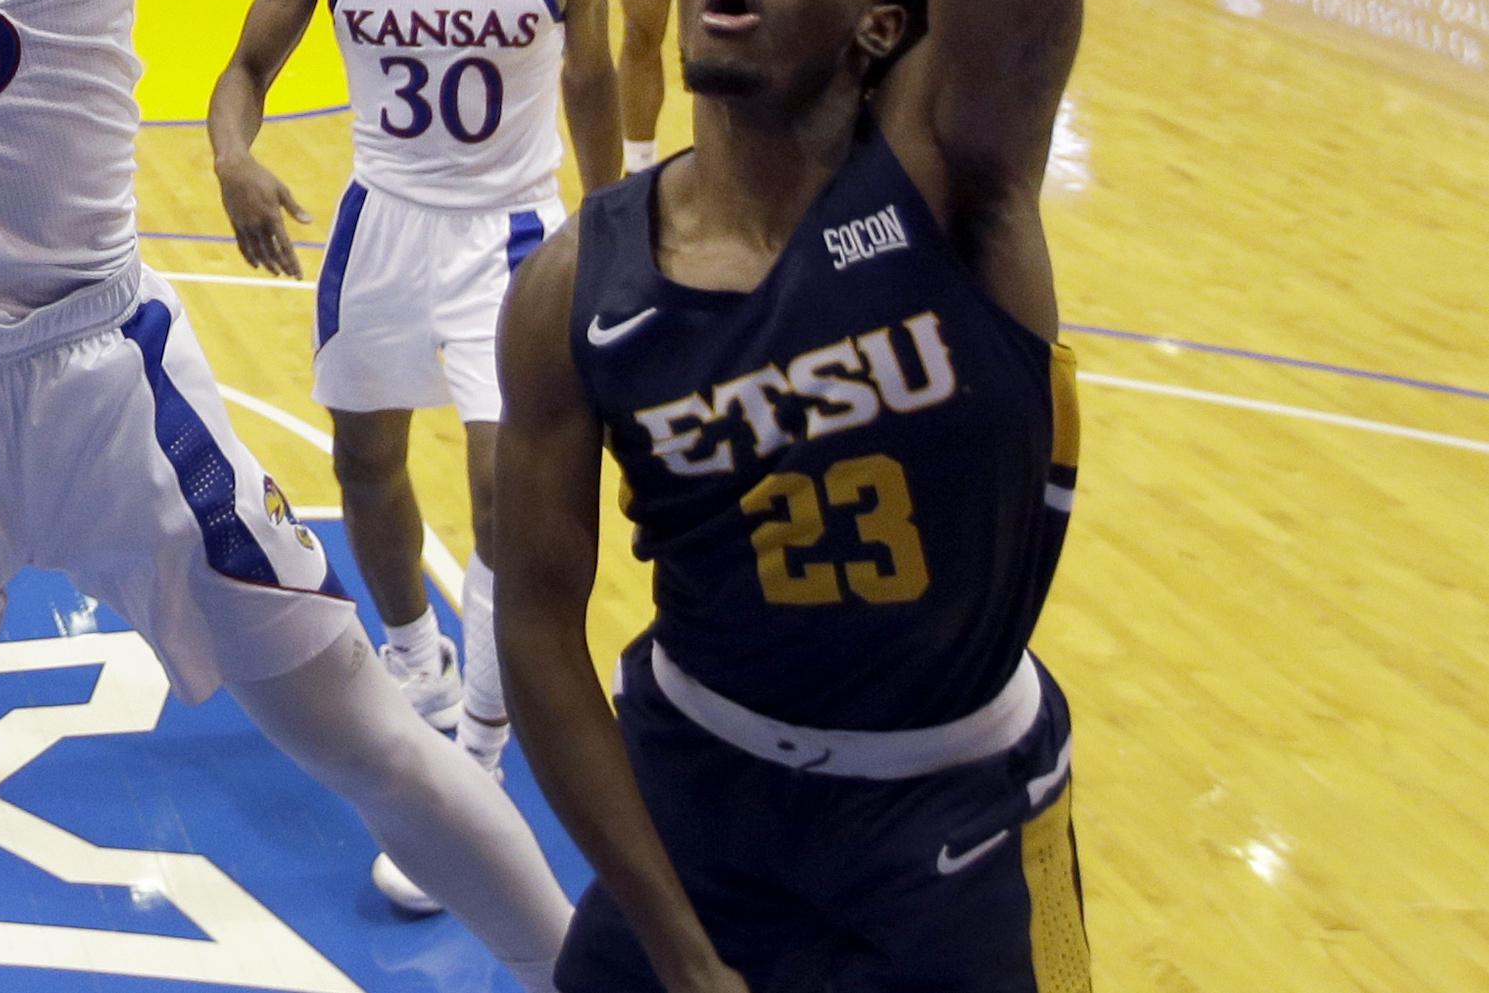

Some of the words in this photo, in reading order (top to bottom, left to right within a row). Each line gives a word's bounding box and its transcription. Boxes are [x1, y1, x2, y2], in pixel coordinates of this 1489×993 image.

[342, 9, 539, 48] KANSAS
[379, 56, 504, 144] 30
[634, 311, 957, 477] ETSU
[740, 453, 930, 605] 23
